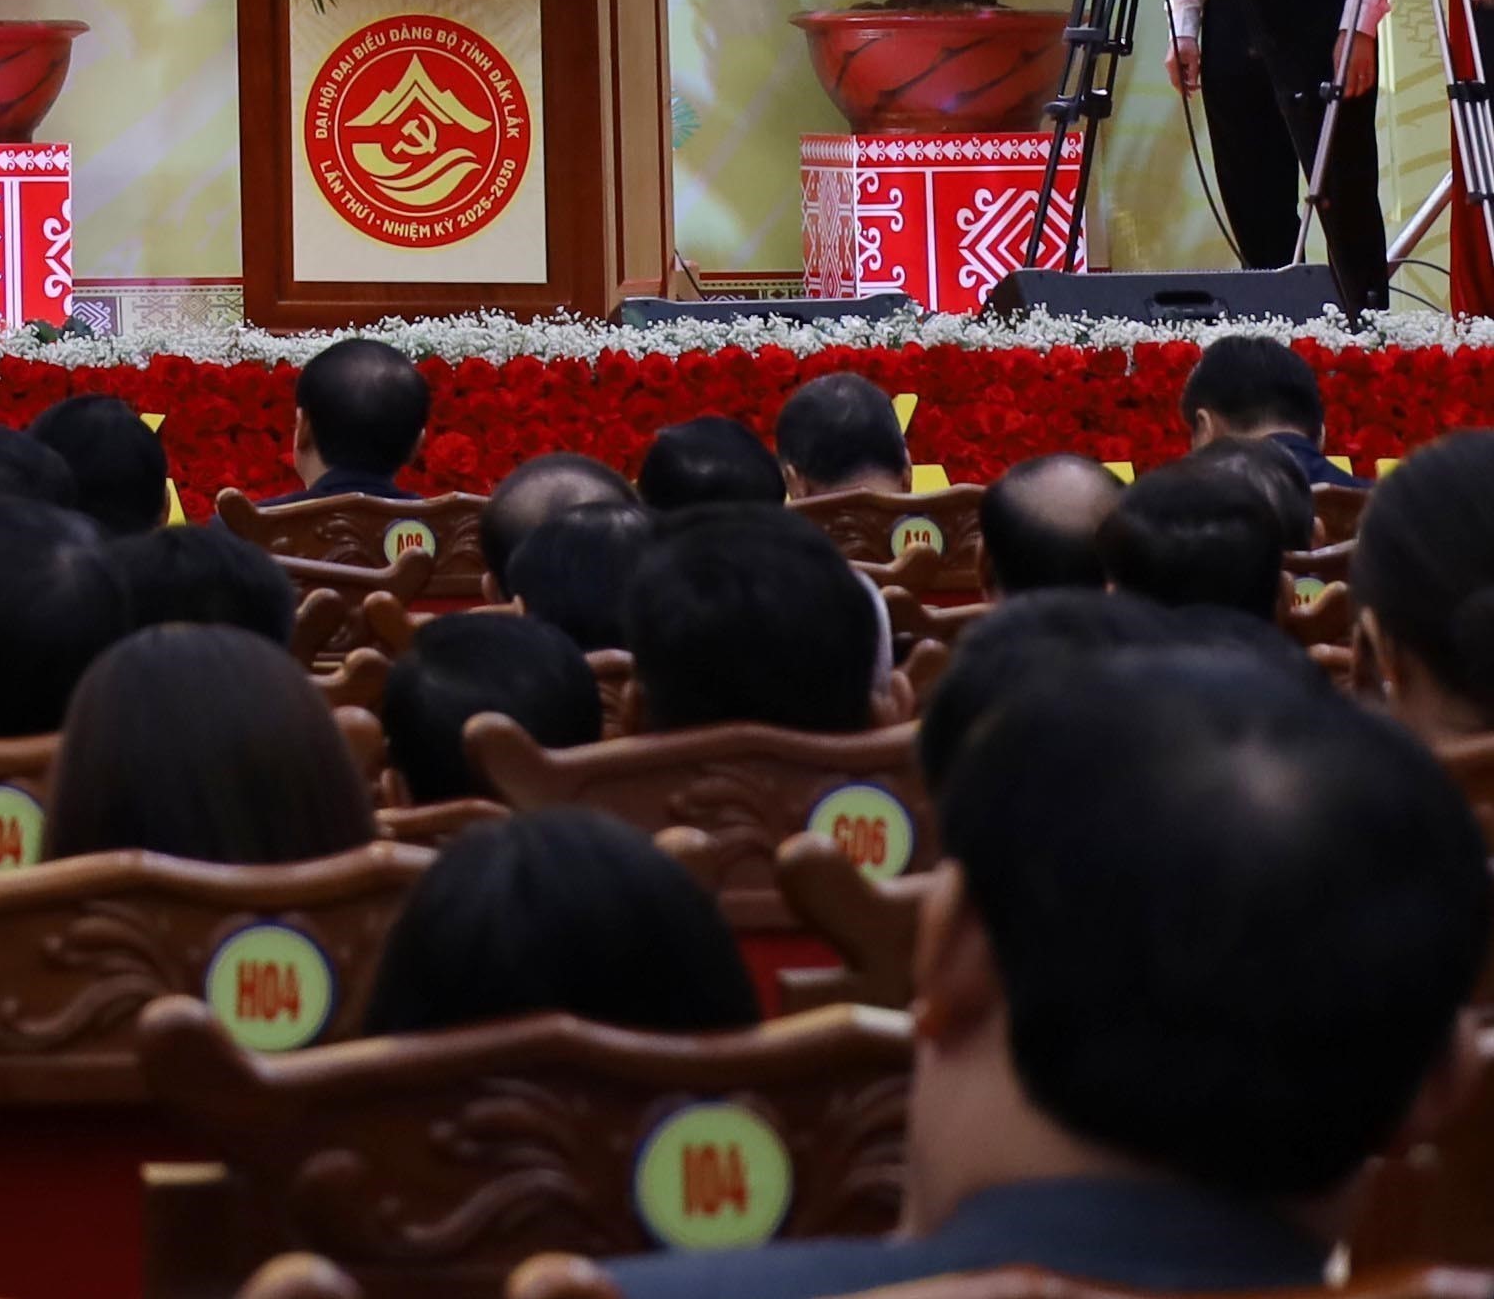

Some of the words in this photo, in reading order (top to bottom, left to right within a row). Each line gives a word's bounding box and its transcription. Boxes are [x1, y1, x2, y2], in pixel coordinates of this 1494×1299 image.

[352, 32, 386, 59] BIỂU
[390, 23, 432, 42] ĐẢNG
[436, 31, 458, 50] BỘ
[332, 55, 354, 81] ĐẠI
[461, 39, 493, 72] TỈNH
[319, 83, 338, 109] HỘI
[488, 69, 514, 101] ĐẮK
[315, 112, 332, 139] ĐẠI
[503, 103, 524, 139] LẮK
[319, 160, 344, 195] LẦN
[340, 191, 369, 220] THỨ
[382, 220, 431, 241] NHIỆM
[433, 217, 454, 237] KỲ
[457, 159, 516, 227] 2025-2030
[236, 961, 302, 1021] H04
